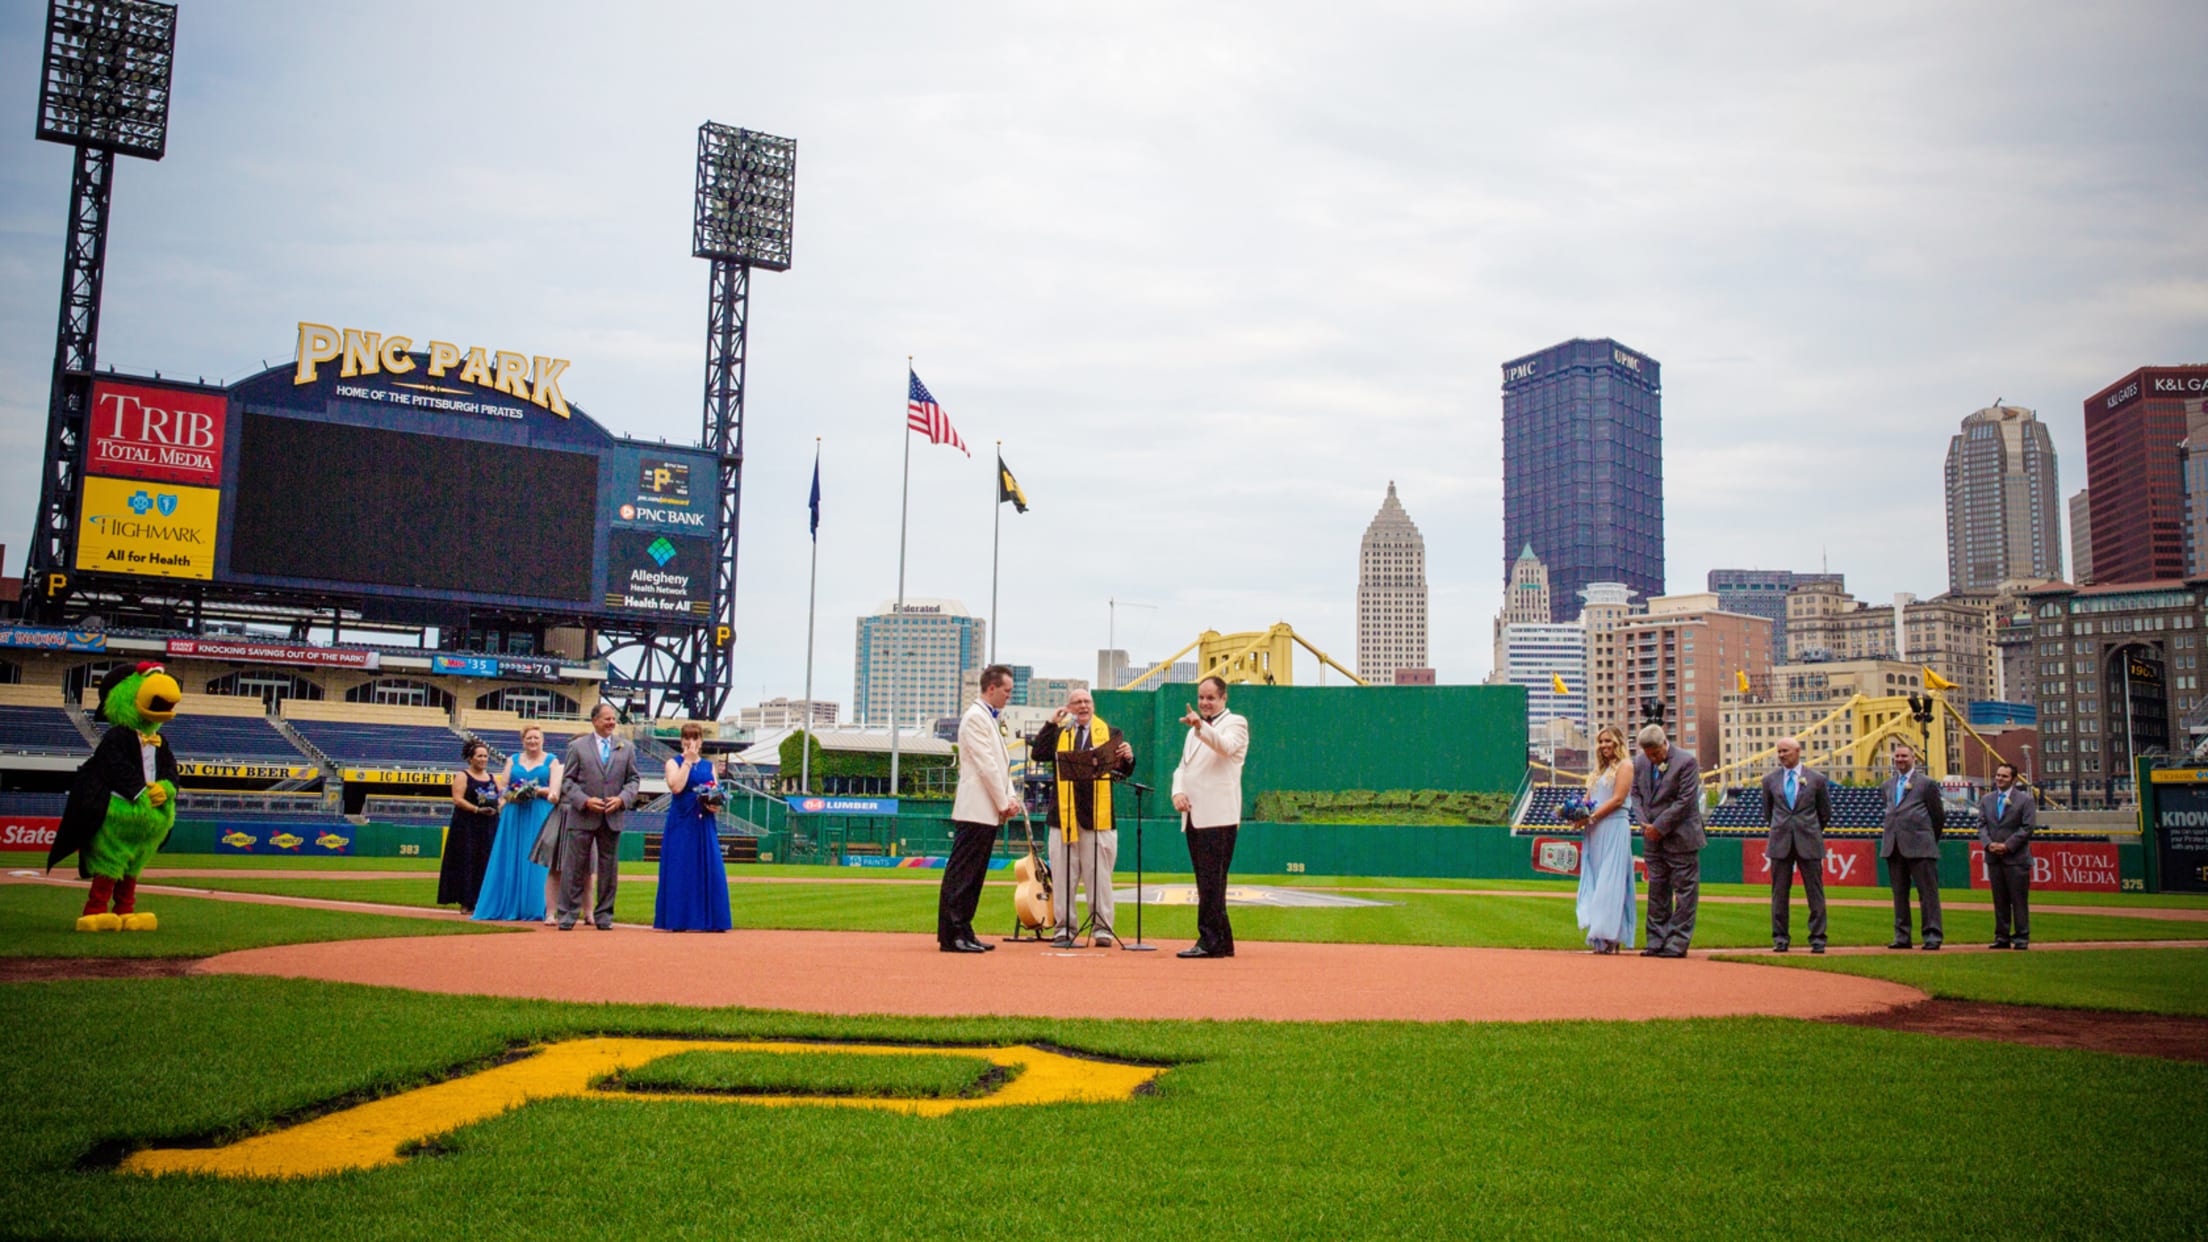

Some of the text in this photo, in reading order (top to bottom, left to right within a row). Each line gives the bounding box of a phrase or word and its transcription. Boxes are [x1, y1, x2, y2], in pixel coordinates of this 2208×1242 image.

[1614, 349, 1641, 373] UPMC
[294, 321, 571, 420] PNC PARK
[2118, 382, 2138, 402] GATES
[2155, 378, 2185, 391] K&L
[336, 385, 524, 419] HOME OF THE PITTSBURGH PIRATES
[99, 392, 214, 448] TRIB
[97, 439, 214, 470] TOTAL MEDIA
[637, 507, 705, 526] PNC BANK
[100, 517, 202, 545] HIGHMARK
[106, 549, 191, 567] All for Health
[47, 573, 68, 597] P
[630, 569, 688, 587] Allegheny
[630, 583, 688, 597] Health Network
[624, 595, 692, 612] Health for All
[716, 626, 732, 646] P
[198, 645, 246, 655] KNOCKING
[247, 648, 285, 658] SAVINGS
[286, 650, 306, 659] OUT
[321, 653, 338, 662] THE
[340, 655, 365, 663] PARK!
[201, 764, 240, 776] CITY
[245, 766, 290, 778] BEER
[380, 770, 392, 782] IC
[397, 772, 439, 783] LIGHT
[826, 801, 879, 810] LUMBER
[3, 825, 57, 845] State
[2057, 851, 2114, 868] TOTAL
[2062, 868, 2116, 884] MEDIA
[2122, 879, 2144, 889] 375
